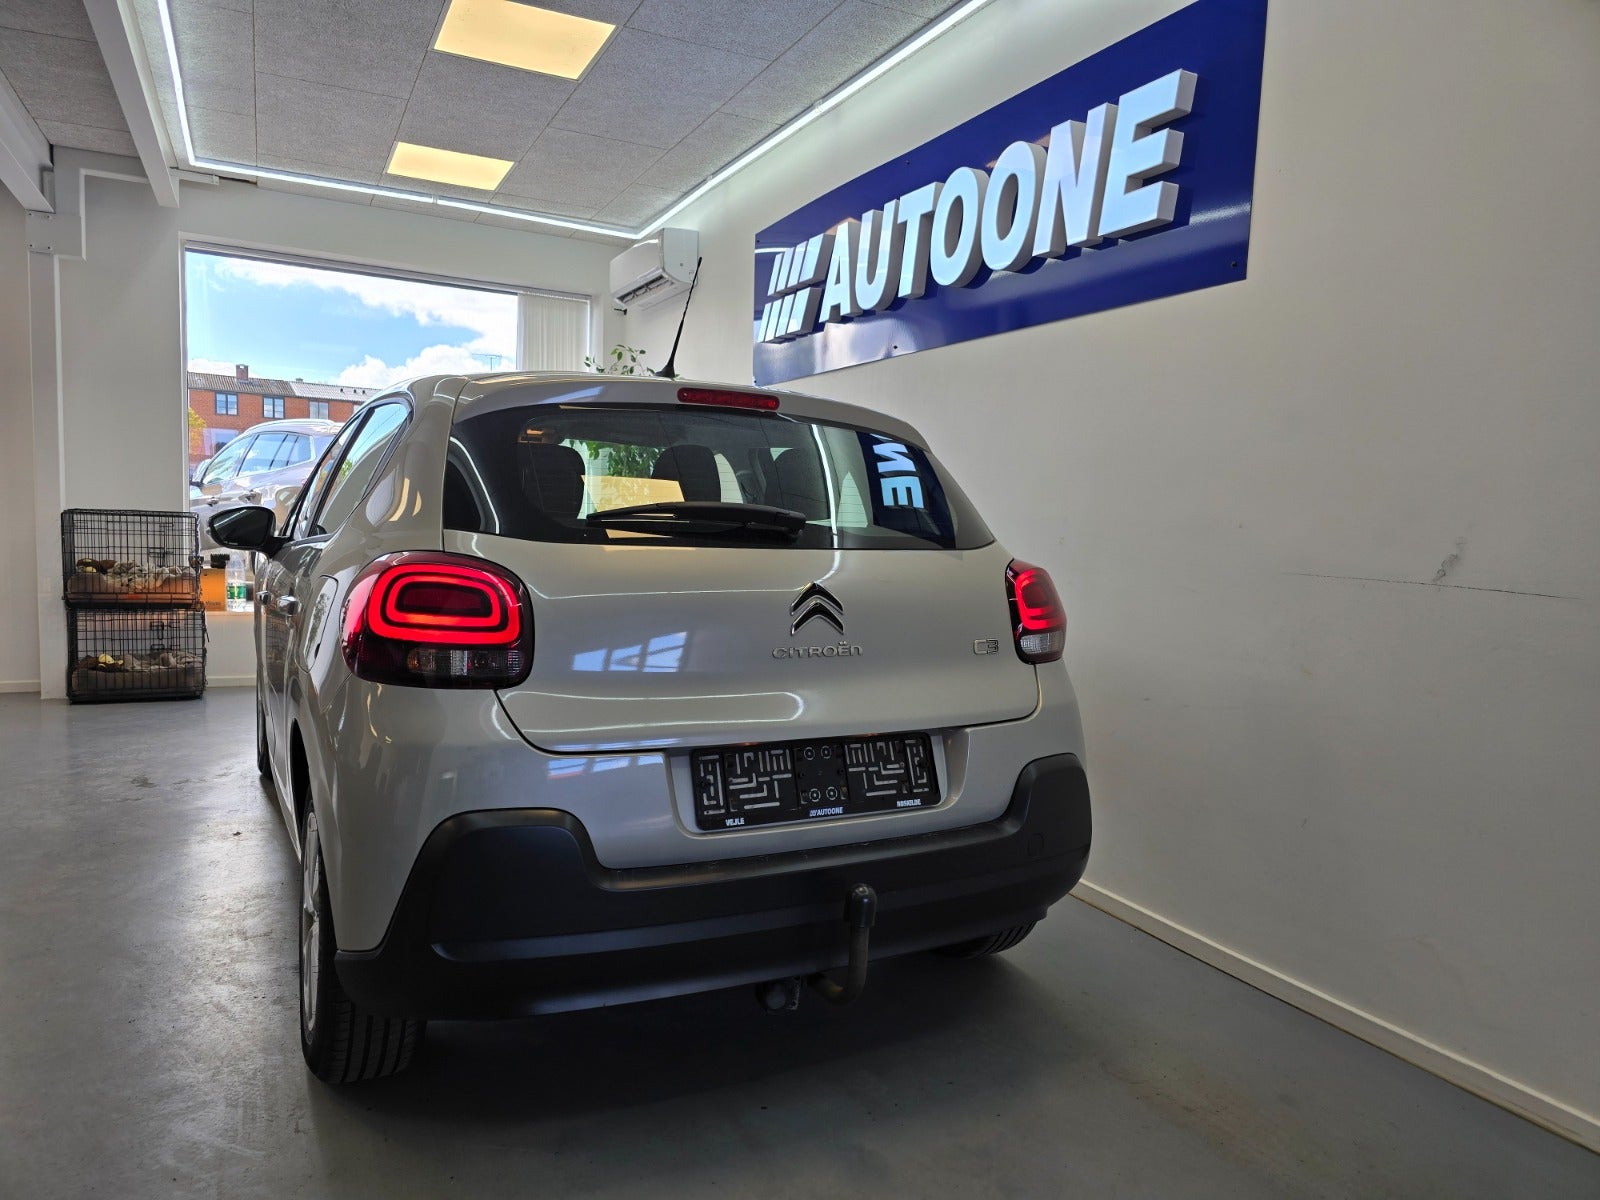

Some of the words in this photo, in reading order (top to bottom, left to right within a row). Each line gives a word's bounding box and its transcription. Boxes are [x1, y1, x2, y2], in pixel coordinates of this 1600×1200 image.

[819, 68, 1197, 323] AUTOONE
[973, 638, 999, 655] C3
[816, 806, 844, 816] AUTOONE
[725, 817, 745, 826] VEJLE
